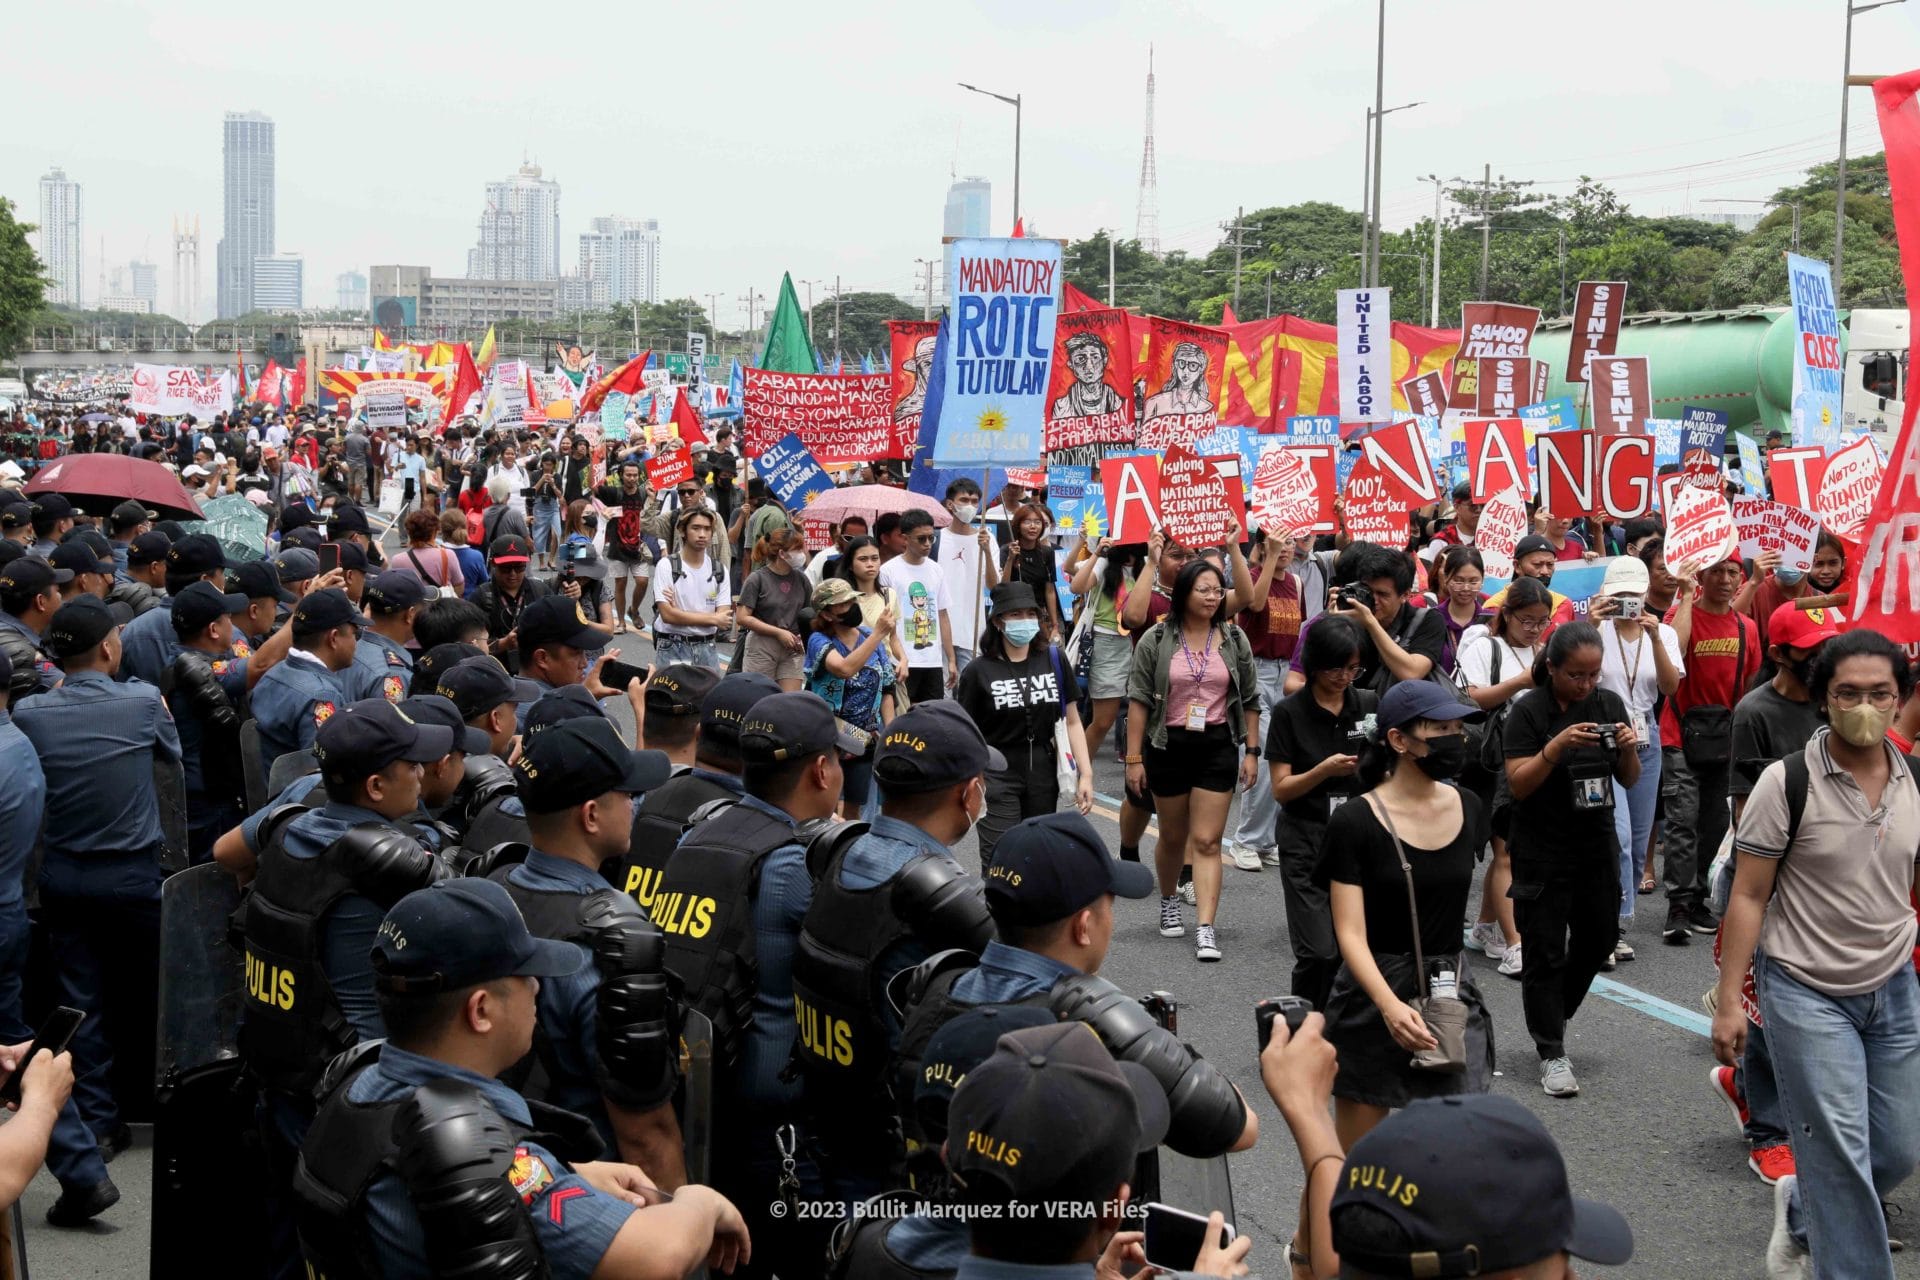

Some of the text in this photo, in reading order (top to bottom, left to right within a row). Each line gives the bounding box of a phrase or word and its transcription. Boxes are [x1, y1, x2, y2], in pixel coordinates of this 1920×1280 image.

[959, 256, 1057, 295] MANDATORY
[1793, 269, 1833, 310] MENTAL
[957, 295, 1053, 359] ROTC
[1798, 305, 1838, 336] HEALTH
[1469, 323, 1527, 344] SAHOD
[1355, 293, 1373, 416] UNITED LABOR
[1803, 332, 1840, 369] CRISIS
[687, 337, 703, 394] PSLINK
[745, 370, 846, 391] KABATAAN
[956, 359, 1047, 395] TUTULAN
[757, 388, 823, 406] SUSUNOD
[743, 400, 856, 421] PROPESYONAL
[1047, 398, 1128, 434] IPAGLABAN
[1525, 406, 1549, 418] TAX
[1691, 410, 1717, 423] NO TO
[744, 414, 821, 431] PAGLABAN
[1142, 411, 1218, 434] IPAGLABAN
[1294, 418, 1332, 436] NO TO
[1683, 420, 1727, 436] MANDATORY
[1060, 422, 1135, 449] PAMBANSANG
[1199, 429, 1240, 451] UPHOLD
[1688, 430, 1716, 448] ROTC!
[656, 452, 678, 466] JUNK
[760, 445, 790, 469] OIL
[1163, 455, 1206, 477] Isulong
[651, 460, 688, 478] MAHARLIKA
[662, 471, 683, 485] SCAM!
[780, 462, 802, 482] LAW
[1171, 472, 1191, 487] ang
[1473, 421, 1526, 497] A
[1539, 434, 1594, 512] N
[1602, 437, 1650, 520] G
[1841, 461, 1857, 478] TO
[777, 462, 822, 502] IBASURA
[1348, 475, 1392, 499] 100%
[1817, 466, 1881, 514] RETENTION
[1160, 496, 1229, 515] SCIENTIFIC,
[1255, 491, 1268, 503] SA
[1344, 496, 1407, 517] face-to-face
[1162, 510, 1231, 528] MASS-ORIENTED
[1347, 515, 1393, 530] classes,
[1486, 499, 1527, 531] DEFEND
[1671, 495, 1726, 529] IBASURA
[1732, 500, 1775, 519] PRESYO
[1785, 505, 1819, 533] PALAY
[1762, 513, 1790, 527] ITAAS
[1171, 522, 1225, 537] EDUCATION
[1352, 522, 1410, 543] NGAYON NA!
[1489, 522, 1512, 538] ACAD
[1475, 529, 1516, 556] FREEDO
[1666, 524, 1732, 565] MAHARLIKA
[1758, 536, 1786, 551] IBABA
[1779, 529, 1811, 553] BIGAS
[652, 676, 679, 692] PULIS
[886, 732, 926, 752] PULIS
[378, 920, 408, 951] PULIS
[246, 949, 296, 1011] PULIS
[793, 991, 855, 1067] PULIS
[967, 1130, 1022, 1167] PULIS
[1349, 1164, 1419, 1207] PULIS
